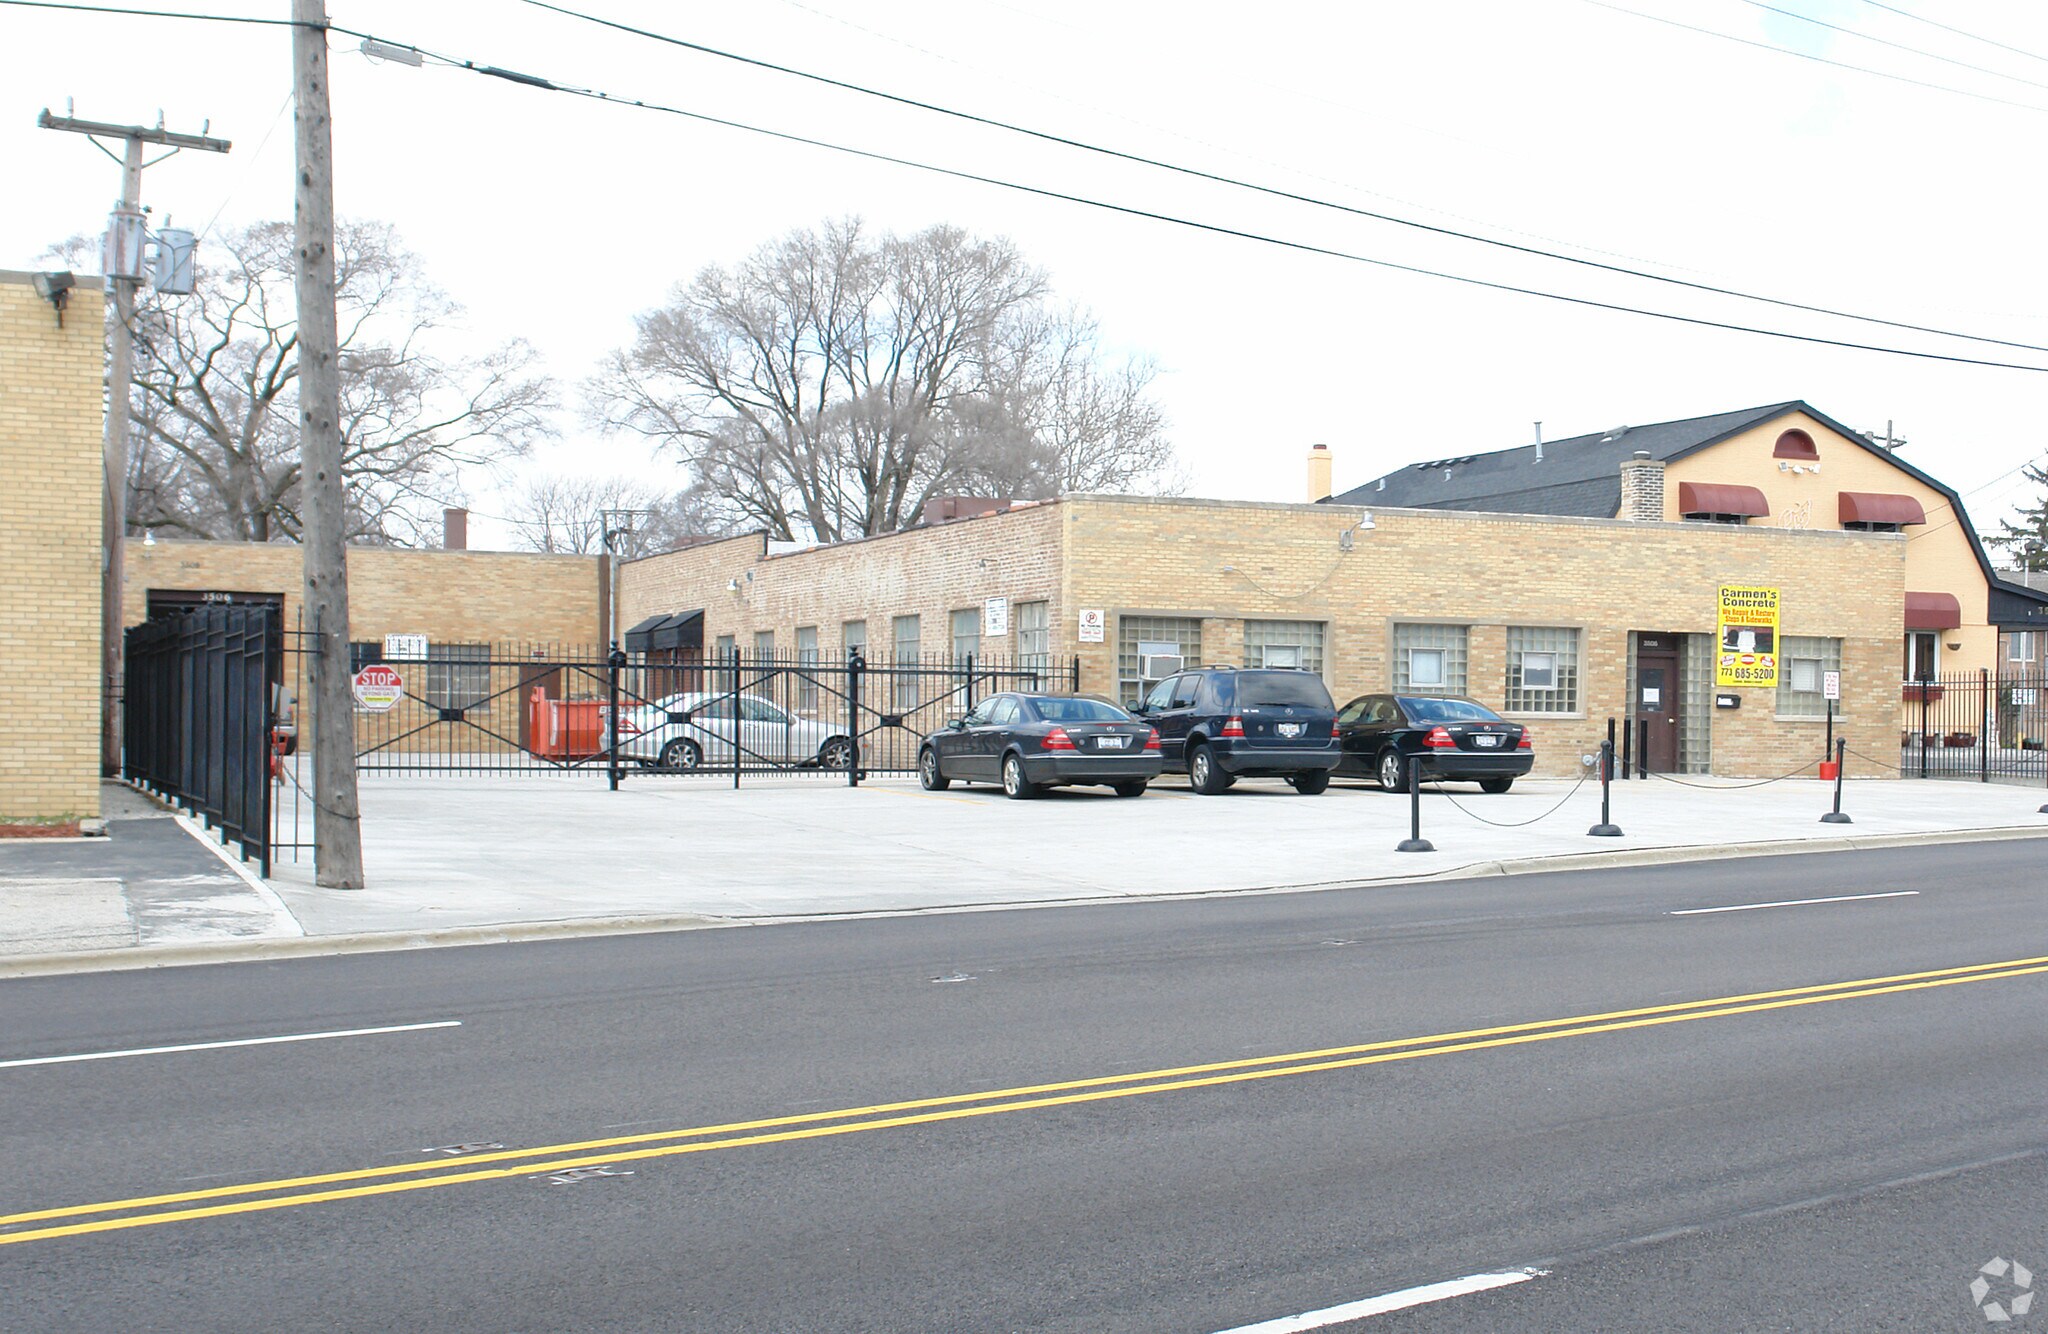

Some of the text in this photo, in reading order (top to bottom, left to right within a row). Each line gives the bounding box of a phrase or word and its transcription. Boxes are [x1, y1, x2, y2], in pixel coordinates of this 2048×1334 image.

[201, 592, 232, 602] 3506
[1721, 588, 1777, 599] Carmen's
[1723, 597, 1775, 608] Concrete
[362, 672, 396, 685] STOP
[1721, 667, 1774, 679] 773 685-5200
